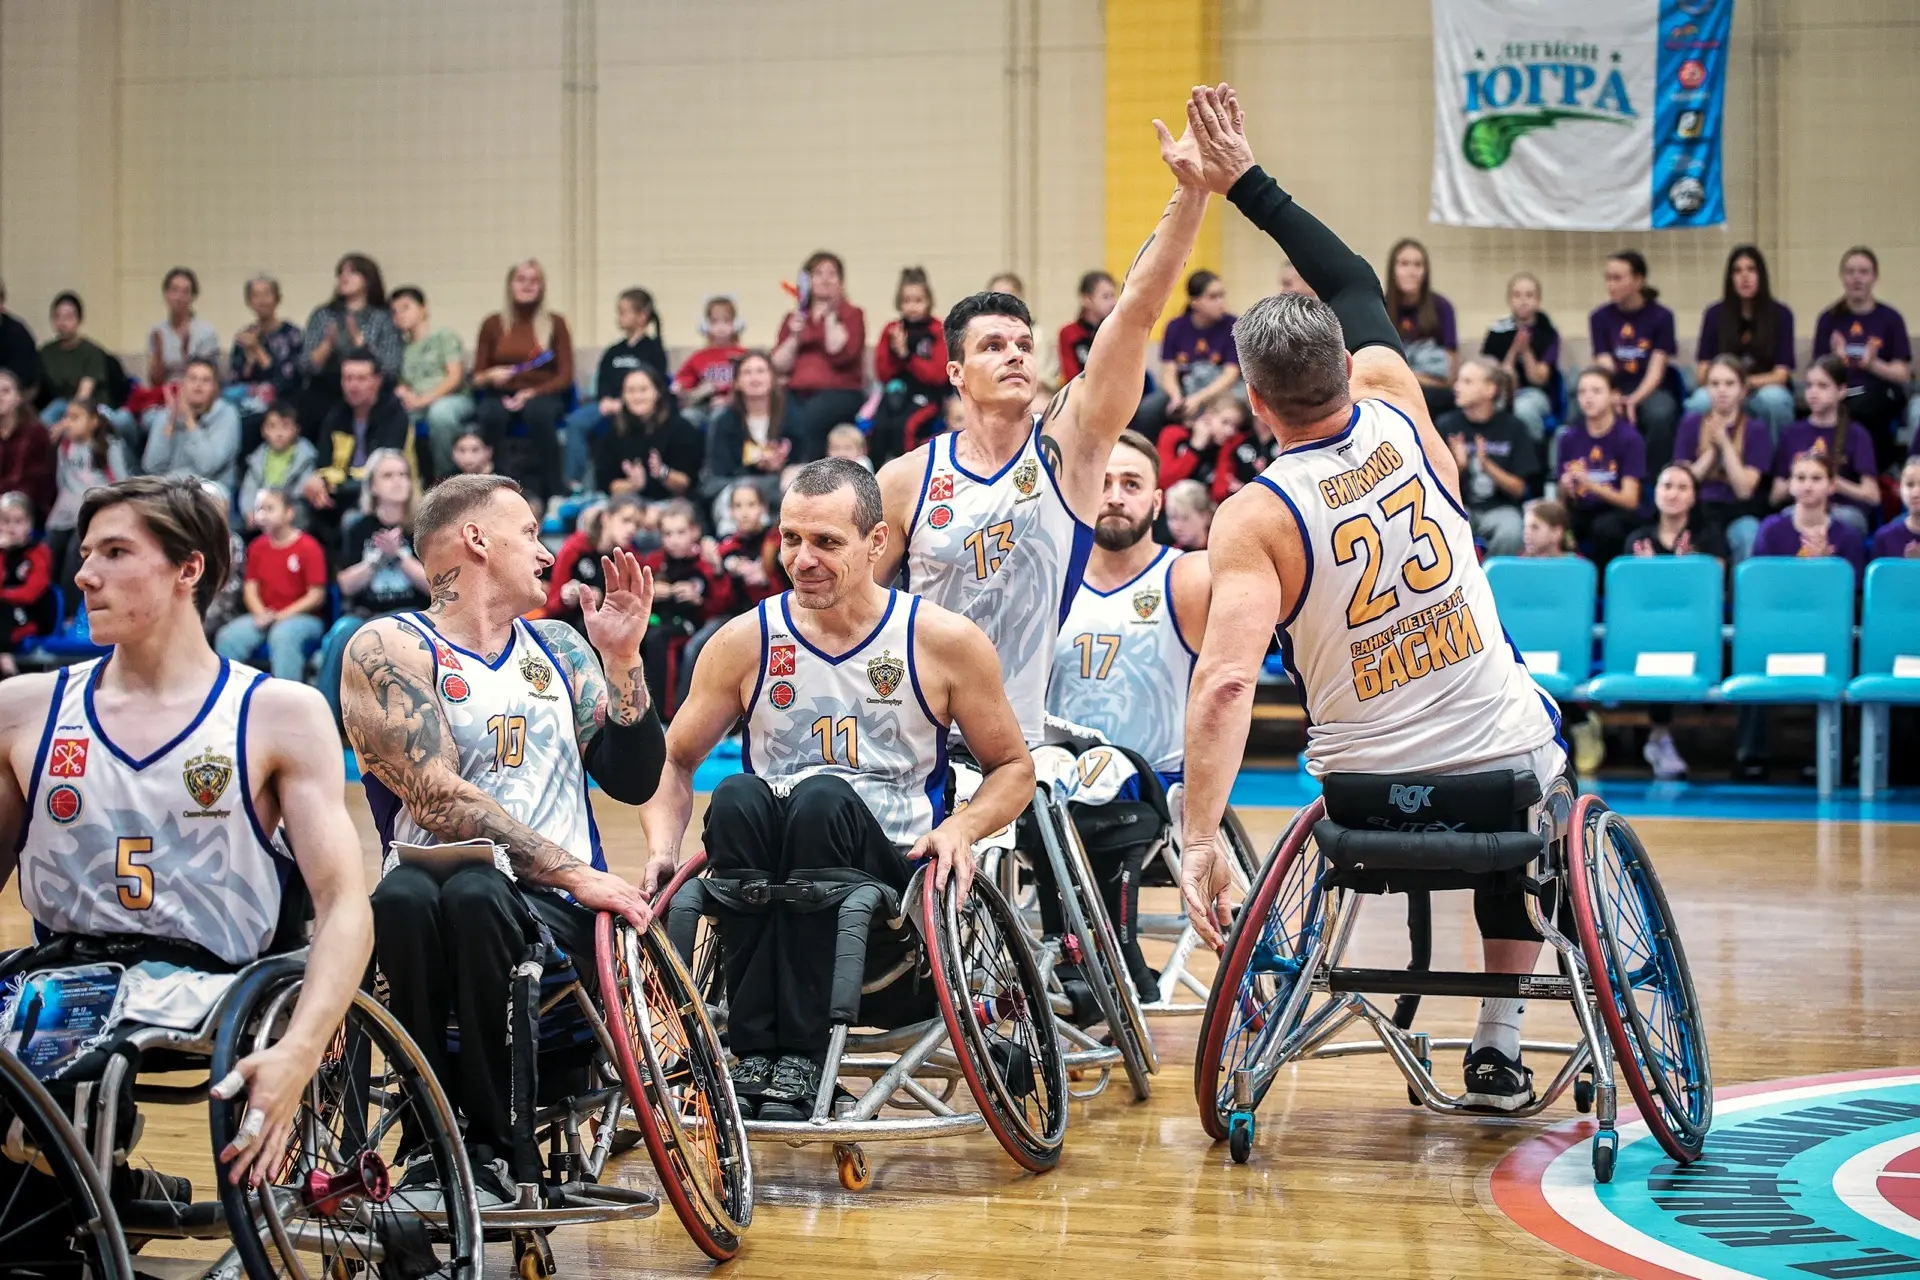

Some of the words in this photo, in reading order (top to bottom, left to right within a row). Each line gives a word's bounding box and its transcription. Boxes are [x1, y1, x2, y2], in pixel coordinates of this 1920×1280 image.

[1464, 62, 1638, 118] ЮГРА
[963, 519, 1016, 580] 13
[1331, 473, 1454, 630] 23
[1350, 585, 1464, 659] САНКТ-ПЕТЕРБУРГ
[1073, 633, 1121, 681] 17
[1352, 603, 1484, 702] БАСКИ
[486, 714, 527, 773] 10
[811, 715, 860, 770] 11
[1388, 783, 1435, 814] RGK
[115, 836, 155, 912] 5
